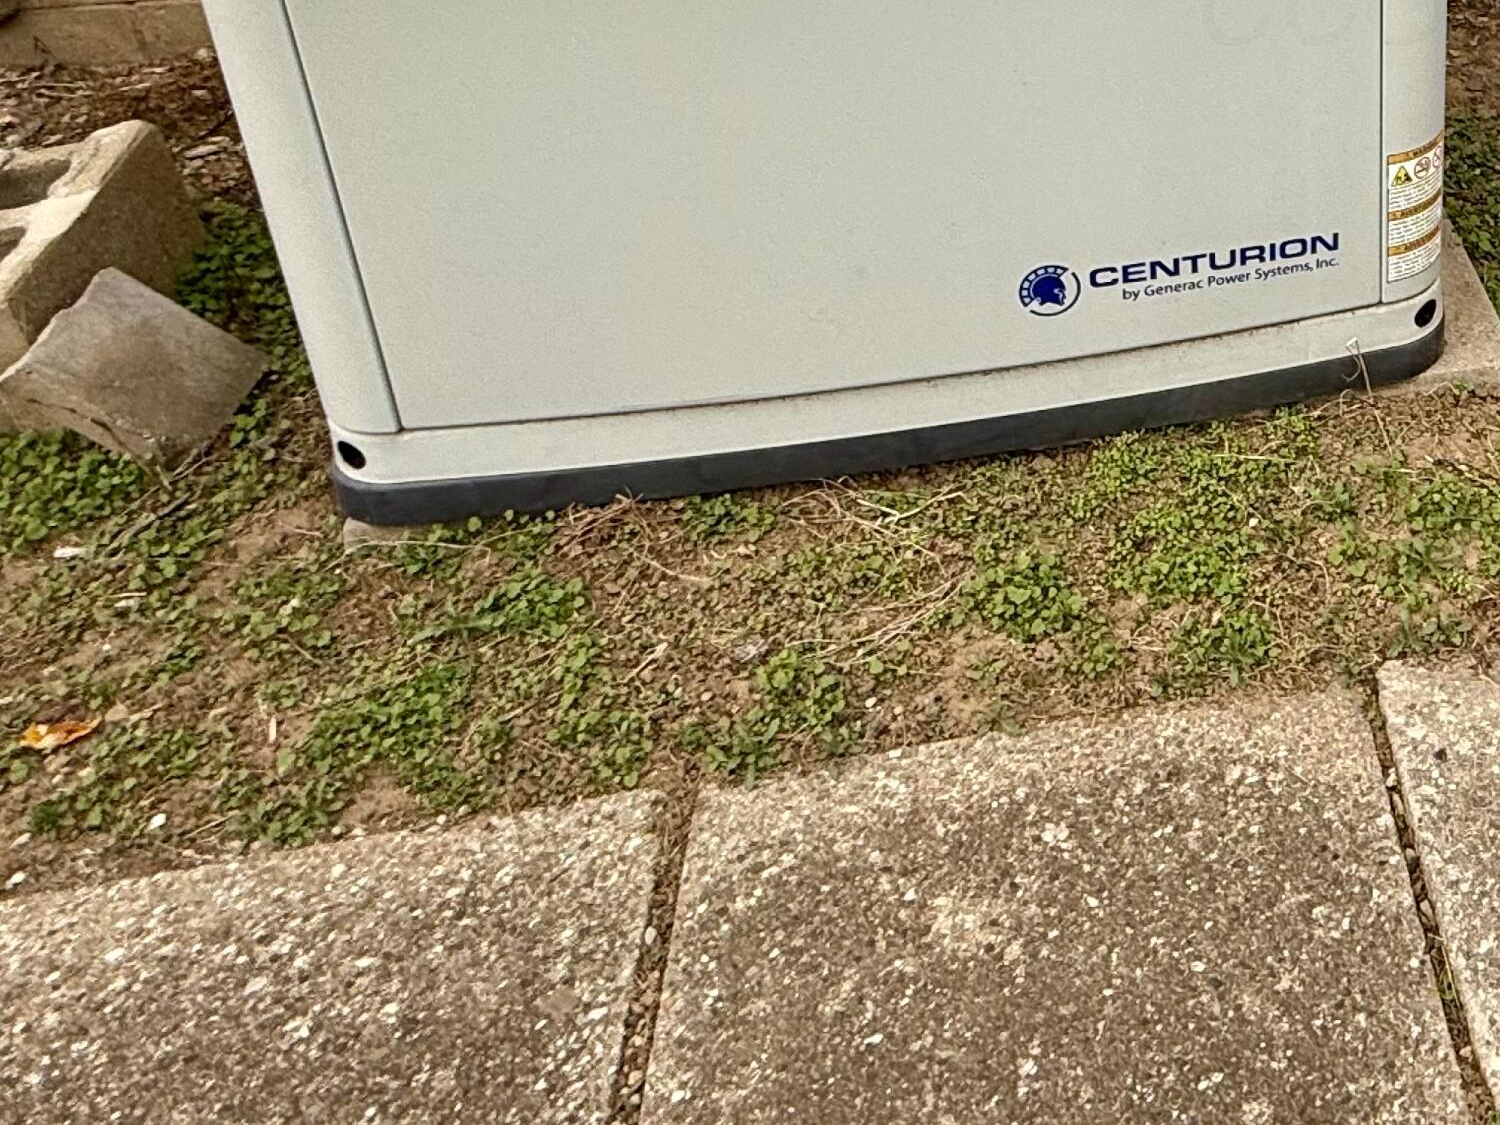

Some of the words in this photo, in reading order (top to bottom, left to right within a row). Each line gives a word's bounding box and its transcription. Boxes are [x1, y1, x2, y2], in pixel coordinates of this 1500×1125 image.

[1089, 232, 1340, 288] CENTURION
[1122, 288, 1140, 301] by
[1144, 280, 1204, 296] Generac
[1207, 272, 1251, 287] Power
[1255, 261, 1313, 280] Systems,
[1316, 257, 1339, 269] Inc.
